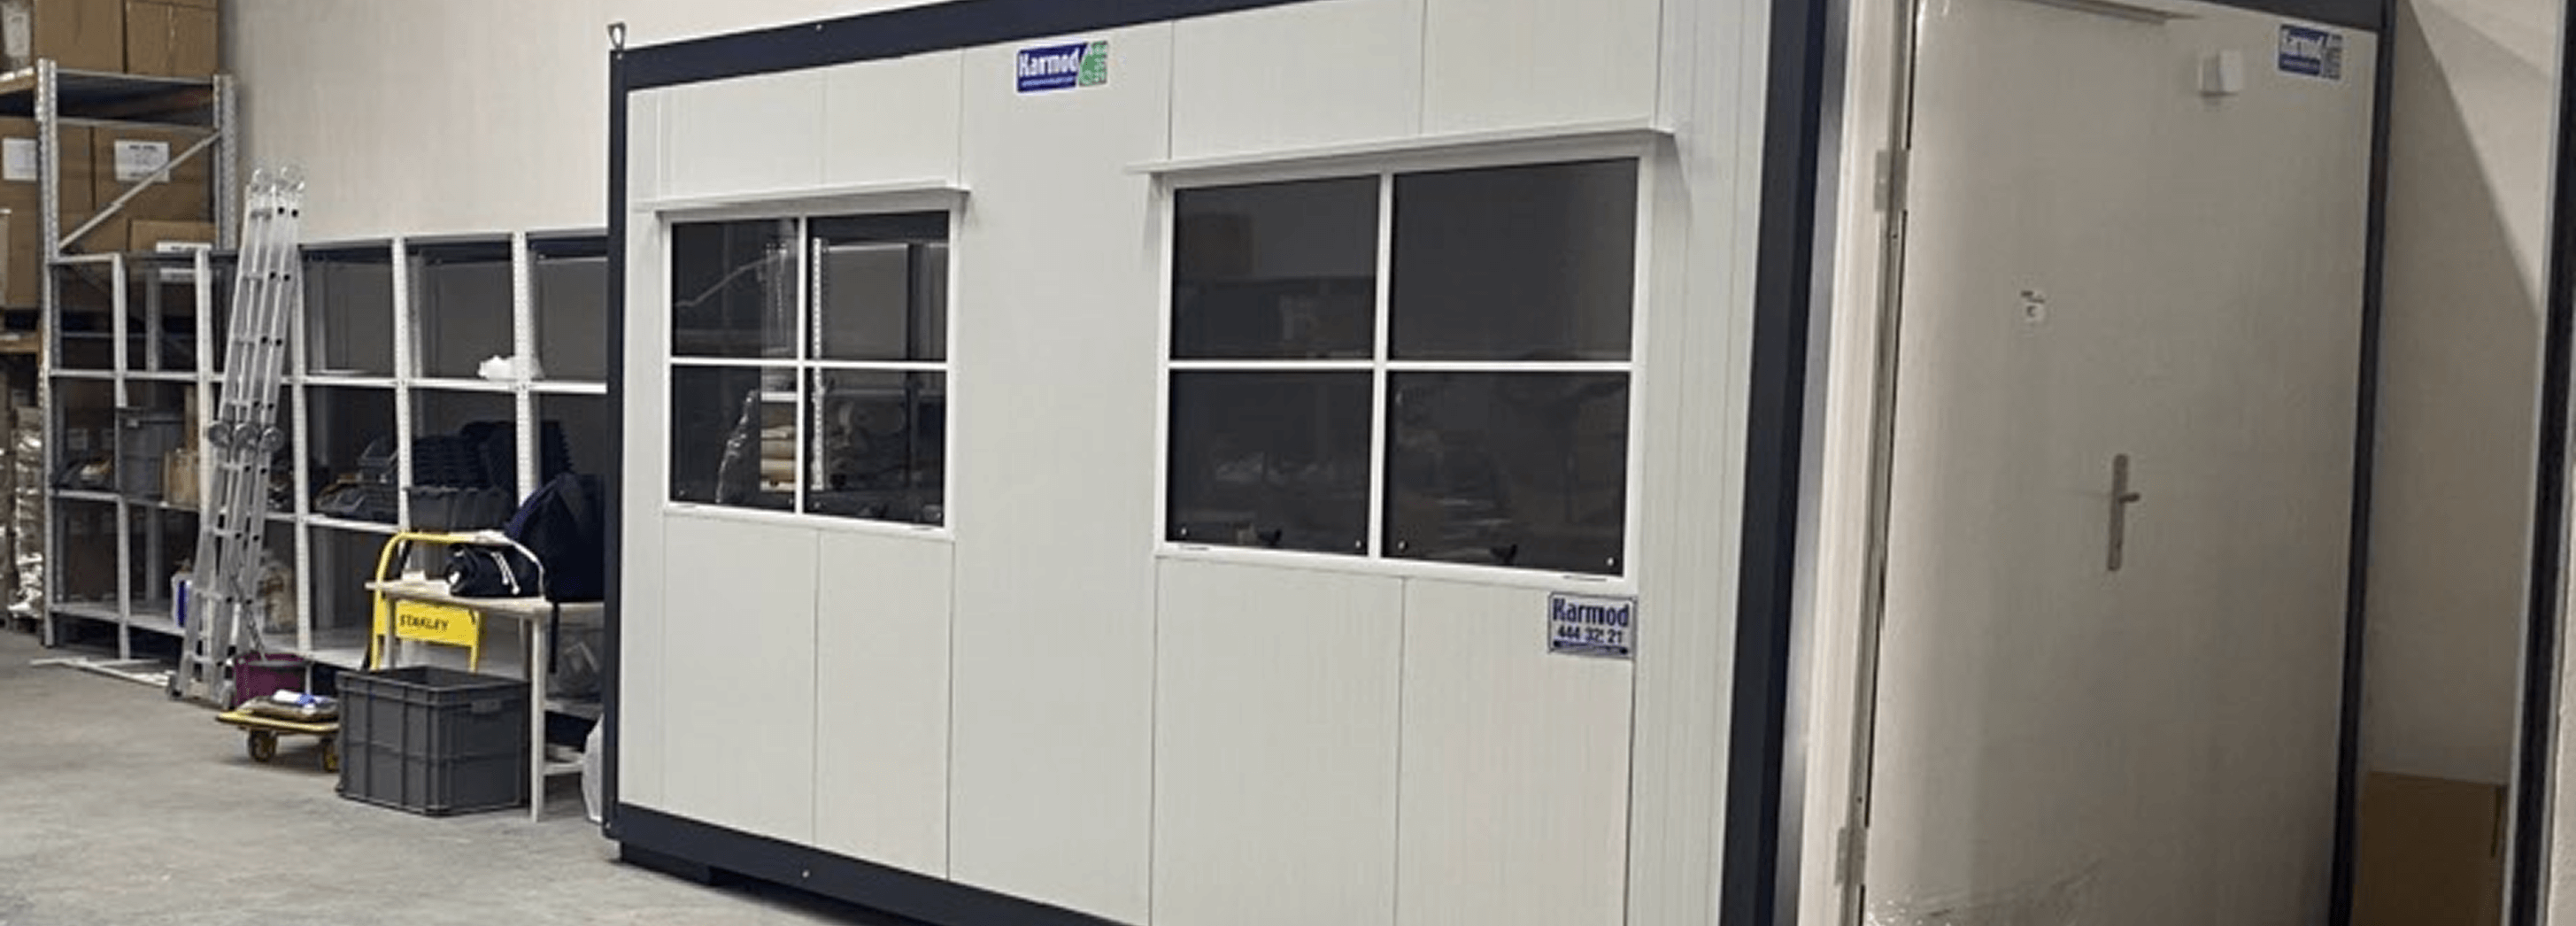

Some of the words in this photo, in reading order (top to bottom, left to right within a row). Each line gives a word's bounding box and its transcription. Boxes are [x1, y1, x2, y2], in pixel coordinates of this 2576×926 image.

[1018, 47, 1080, 77] Karmod
[1553, 598, 1630, 627] Karmod
[1558, 625, 1580, 639] 444
[1608, 629, 1623, 644] 21
